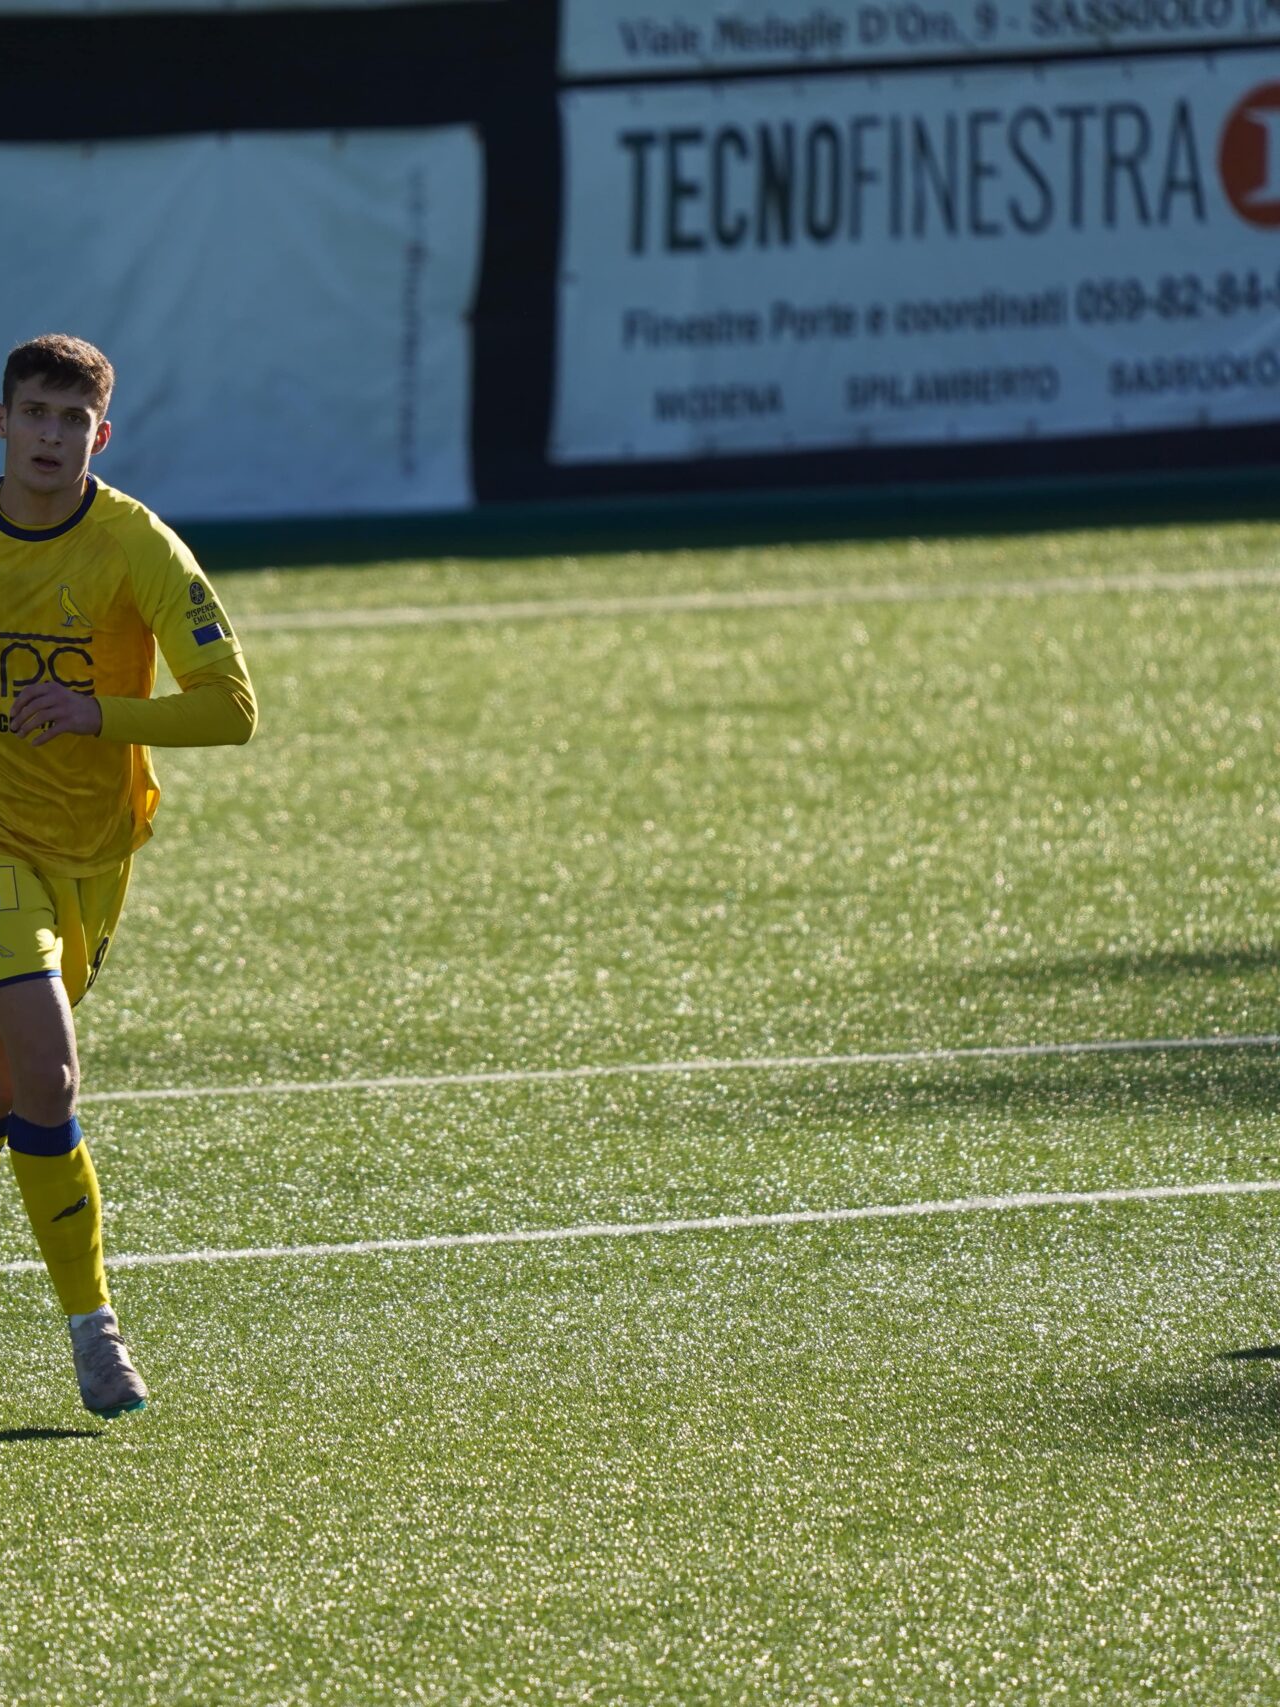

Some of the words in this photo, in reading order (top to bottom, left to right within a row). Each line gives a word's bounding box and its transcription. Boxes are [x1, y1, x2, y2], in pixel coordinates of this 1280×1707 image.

[617, 97, 1207, 257] TECNOFINESTRA
[622, 306, 763, 351] Finestre
[770, 299, 858, 343] Porte
[864, 302, 889, 338] e
[895, 285, 1068, 338] coordinati
[1076, 268, 1280, 326] 059-82-84-
[653, 383, 784, 422] MODENA
[843, 364, 1061, 413] SPILAMBERTO
[185, 602, 218, 619] DISPENSA
[193, 611, 217, 625] EMILIA
